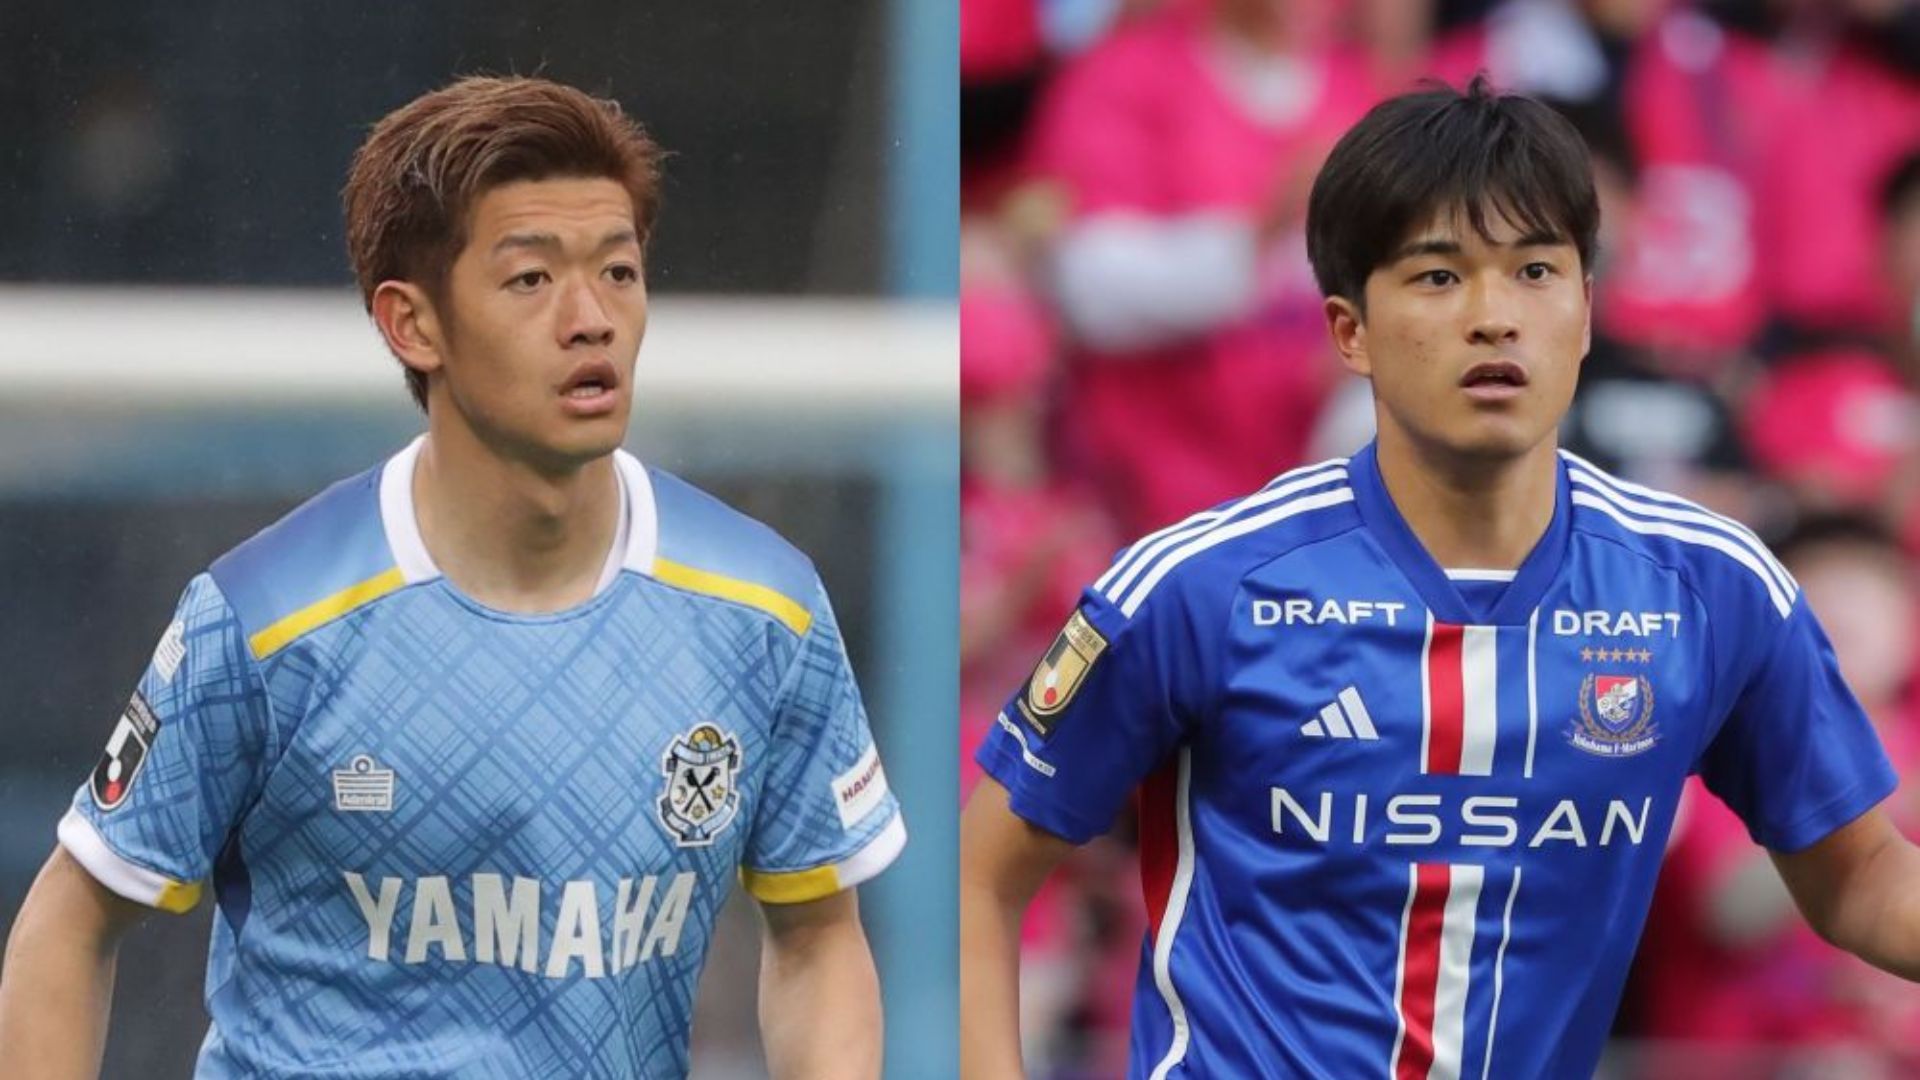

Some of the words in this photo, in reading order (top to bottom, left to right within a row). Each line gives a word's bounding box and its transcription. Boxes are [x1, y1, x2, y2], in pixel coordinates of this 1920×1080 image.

[1252, 599, 1405, 627] DRAFT
[1553, 609, 1681, 639] DRAFT
[1271, 786, 1652, 847] NISSAN
[343, 871, 697, 979] YAMAHA
